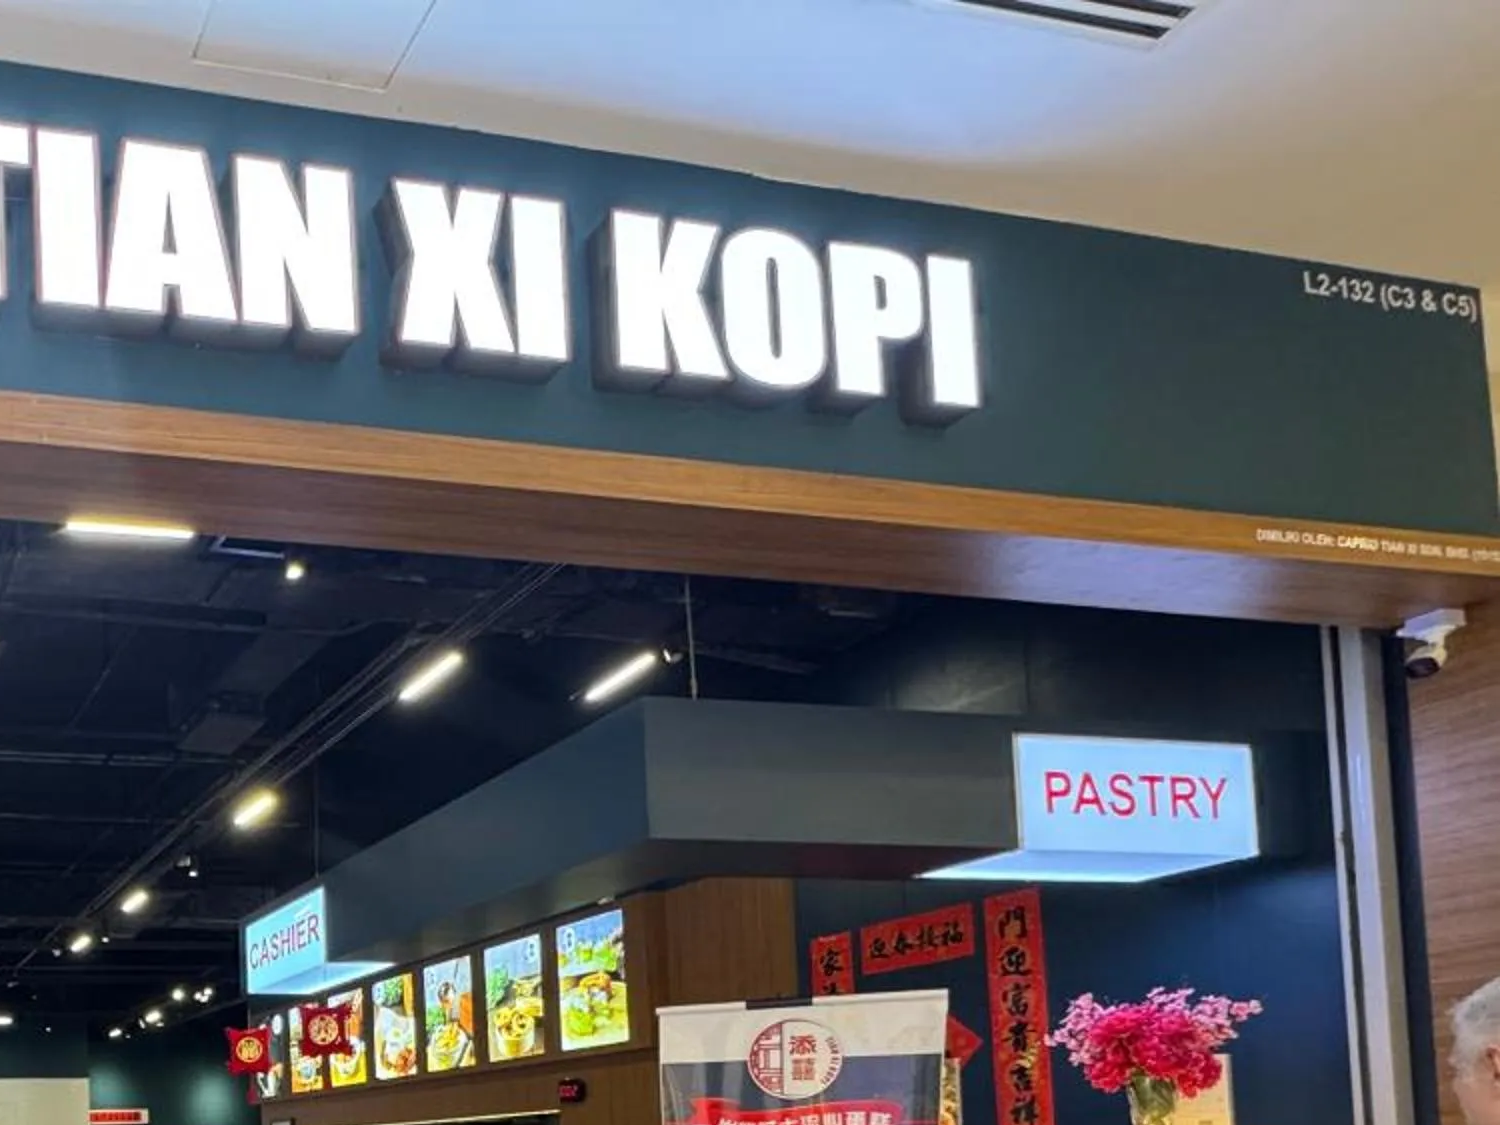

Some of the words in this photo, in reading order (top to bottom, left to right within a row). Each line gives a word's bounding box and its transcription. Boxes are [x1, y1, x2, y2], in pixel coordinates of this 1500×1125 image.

[389, 177, 572, 362] XI
[609, 208, 980, 409] KOPI
[1303, 271, 1376, 303] L2-132
[1380, 284, 1416, 311] (C3
[1421, 289, 1437, 313] &
[1443, 293, 1477, 322] C5)
[1044, 770, 1227, 820] PASTRY
[250, 914, 321, 969] CASHIER
